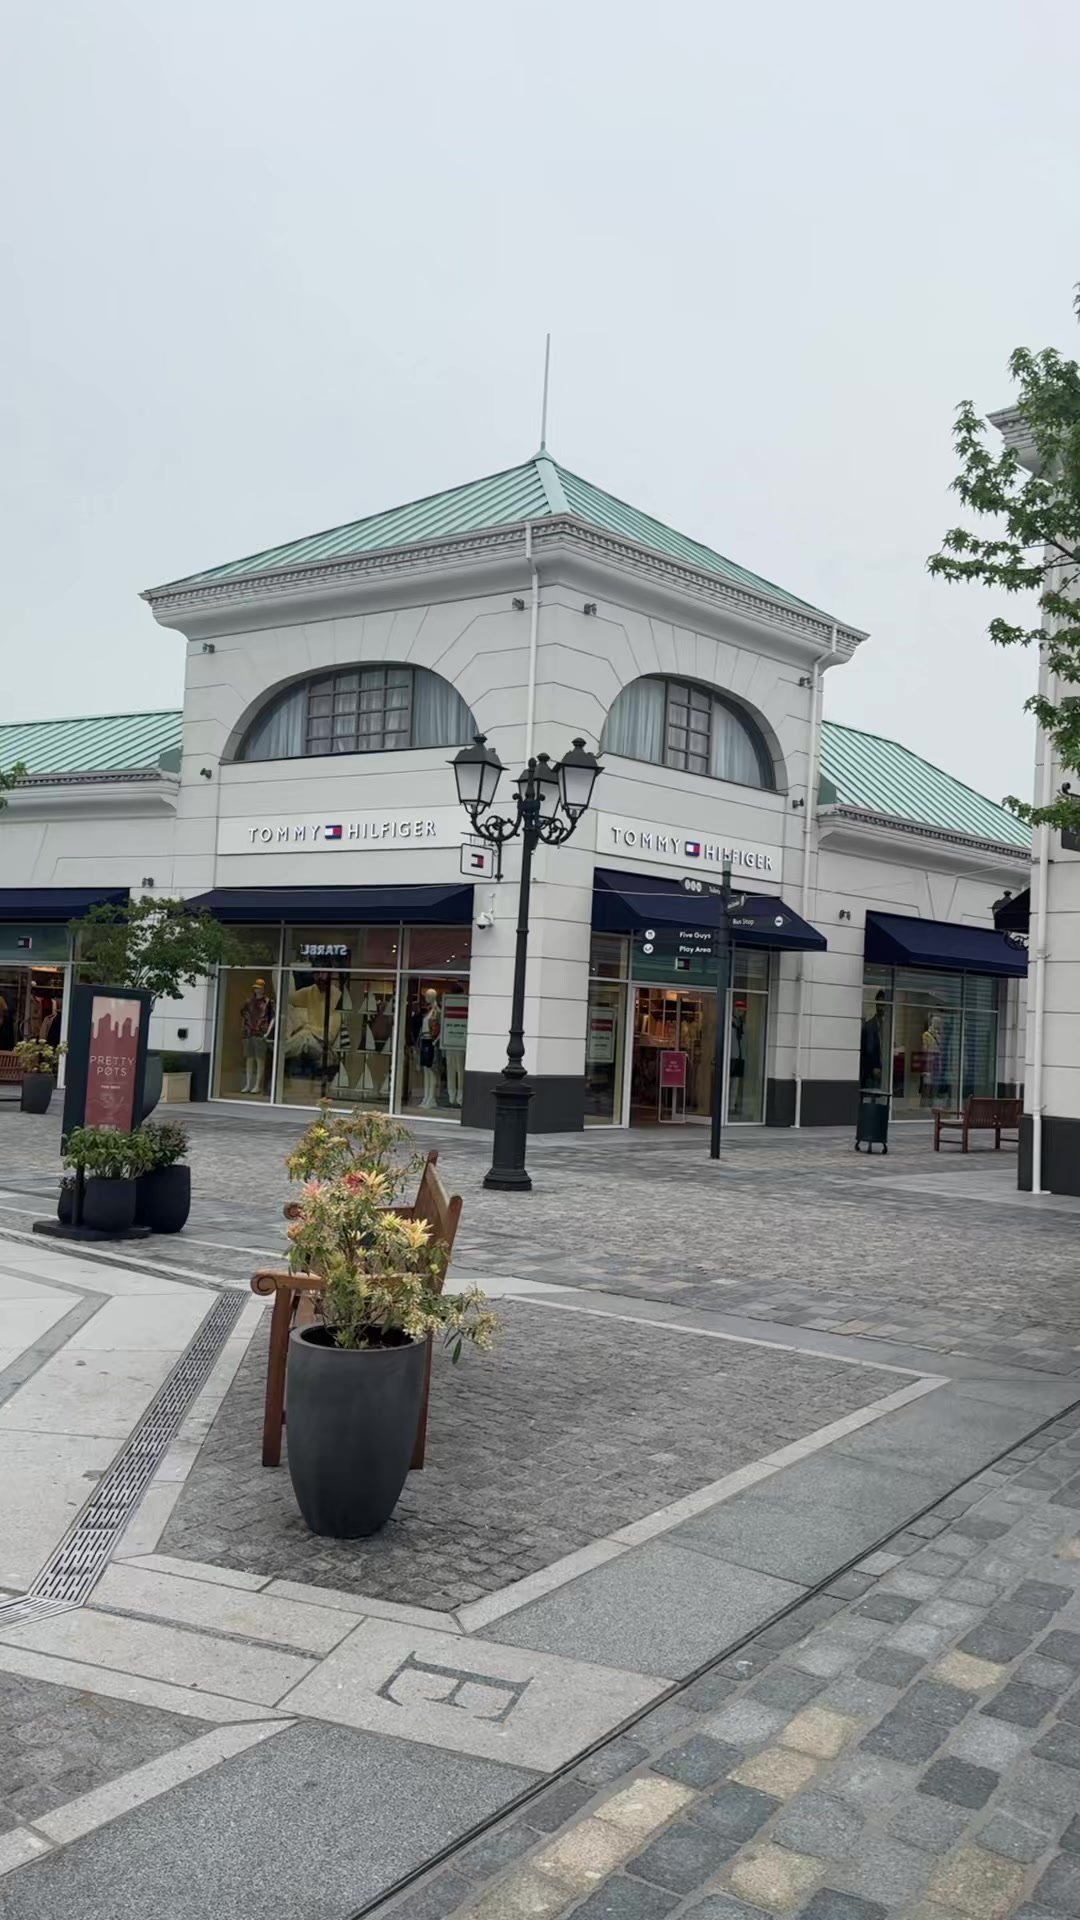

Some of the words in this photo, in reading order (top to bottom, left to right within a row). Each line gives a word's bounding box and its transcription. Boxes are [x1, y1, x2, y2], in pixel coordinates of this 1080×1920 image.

[249, 825, 320, 844] TOMMY
[348, 820, 436, 840] HILFIGER
[611, 826, 681, 854] TOMMY
[704, 844, 772, 871] HILFIGER
[742, 918, 755, 926] Stop
[693, 932, 711, 940] Guys
[679, 945, 694, 954] Play
[90, 1055, 135, 1066] PRETTY
[375, 1650, 534, 1724] E
